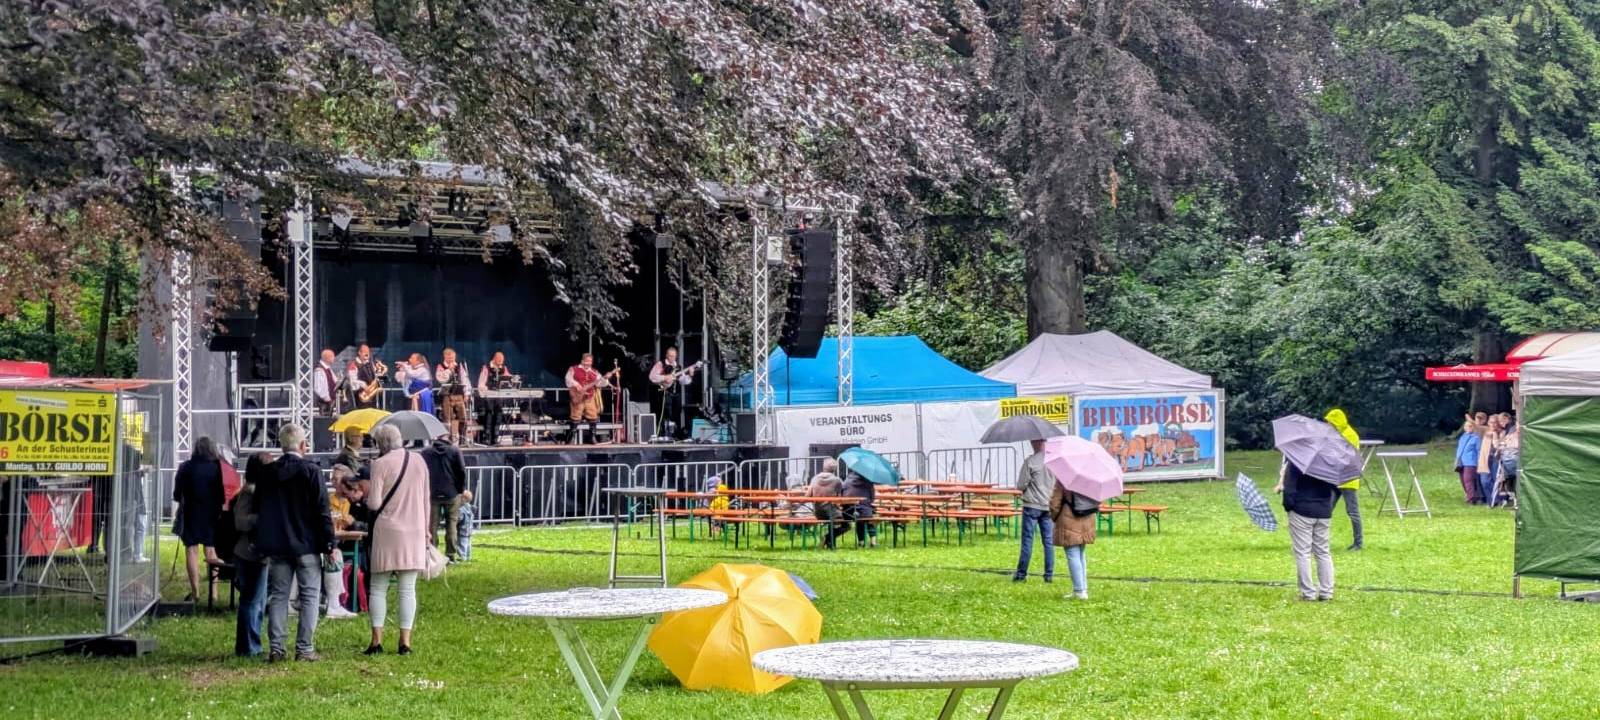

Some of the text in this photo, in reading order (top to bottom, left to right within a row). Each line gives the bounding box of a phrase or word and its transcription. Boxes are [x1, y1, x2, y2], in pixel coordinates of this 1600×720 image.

[1083, 397, 1213, 427] BIERBÖRSE
[0, 405, 111, 443] BÖRSE
[810, 413, 893, 427] VERANSTALTUNGS
[840, 425, 865, 436] BÜRO
[16, 444, 110, 454] An der Schusterinsel
[5, 463, 34, 471] Montag,
[55, 463, 84, 471] GUILDO
[85, 463, 107, 471] HORN
